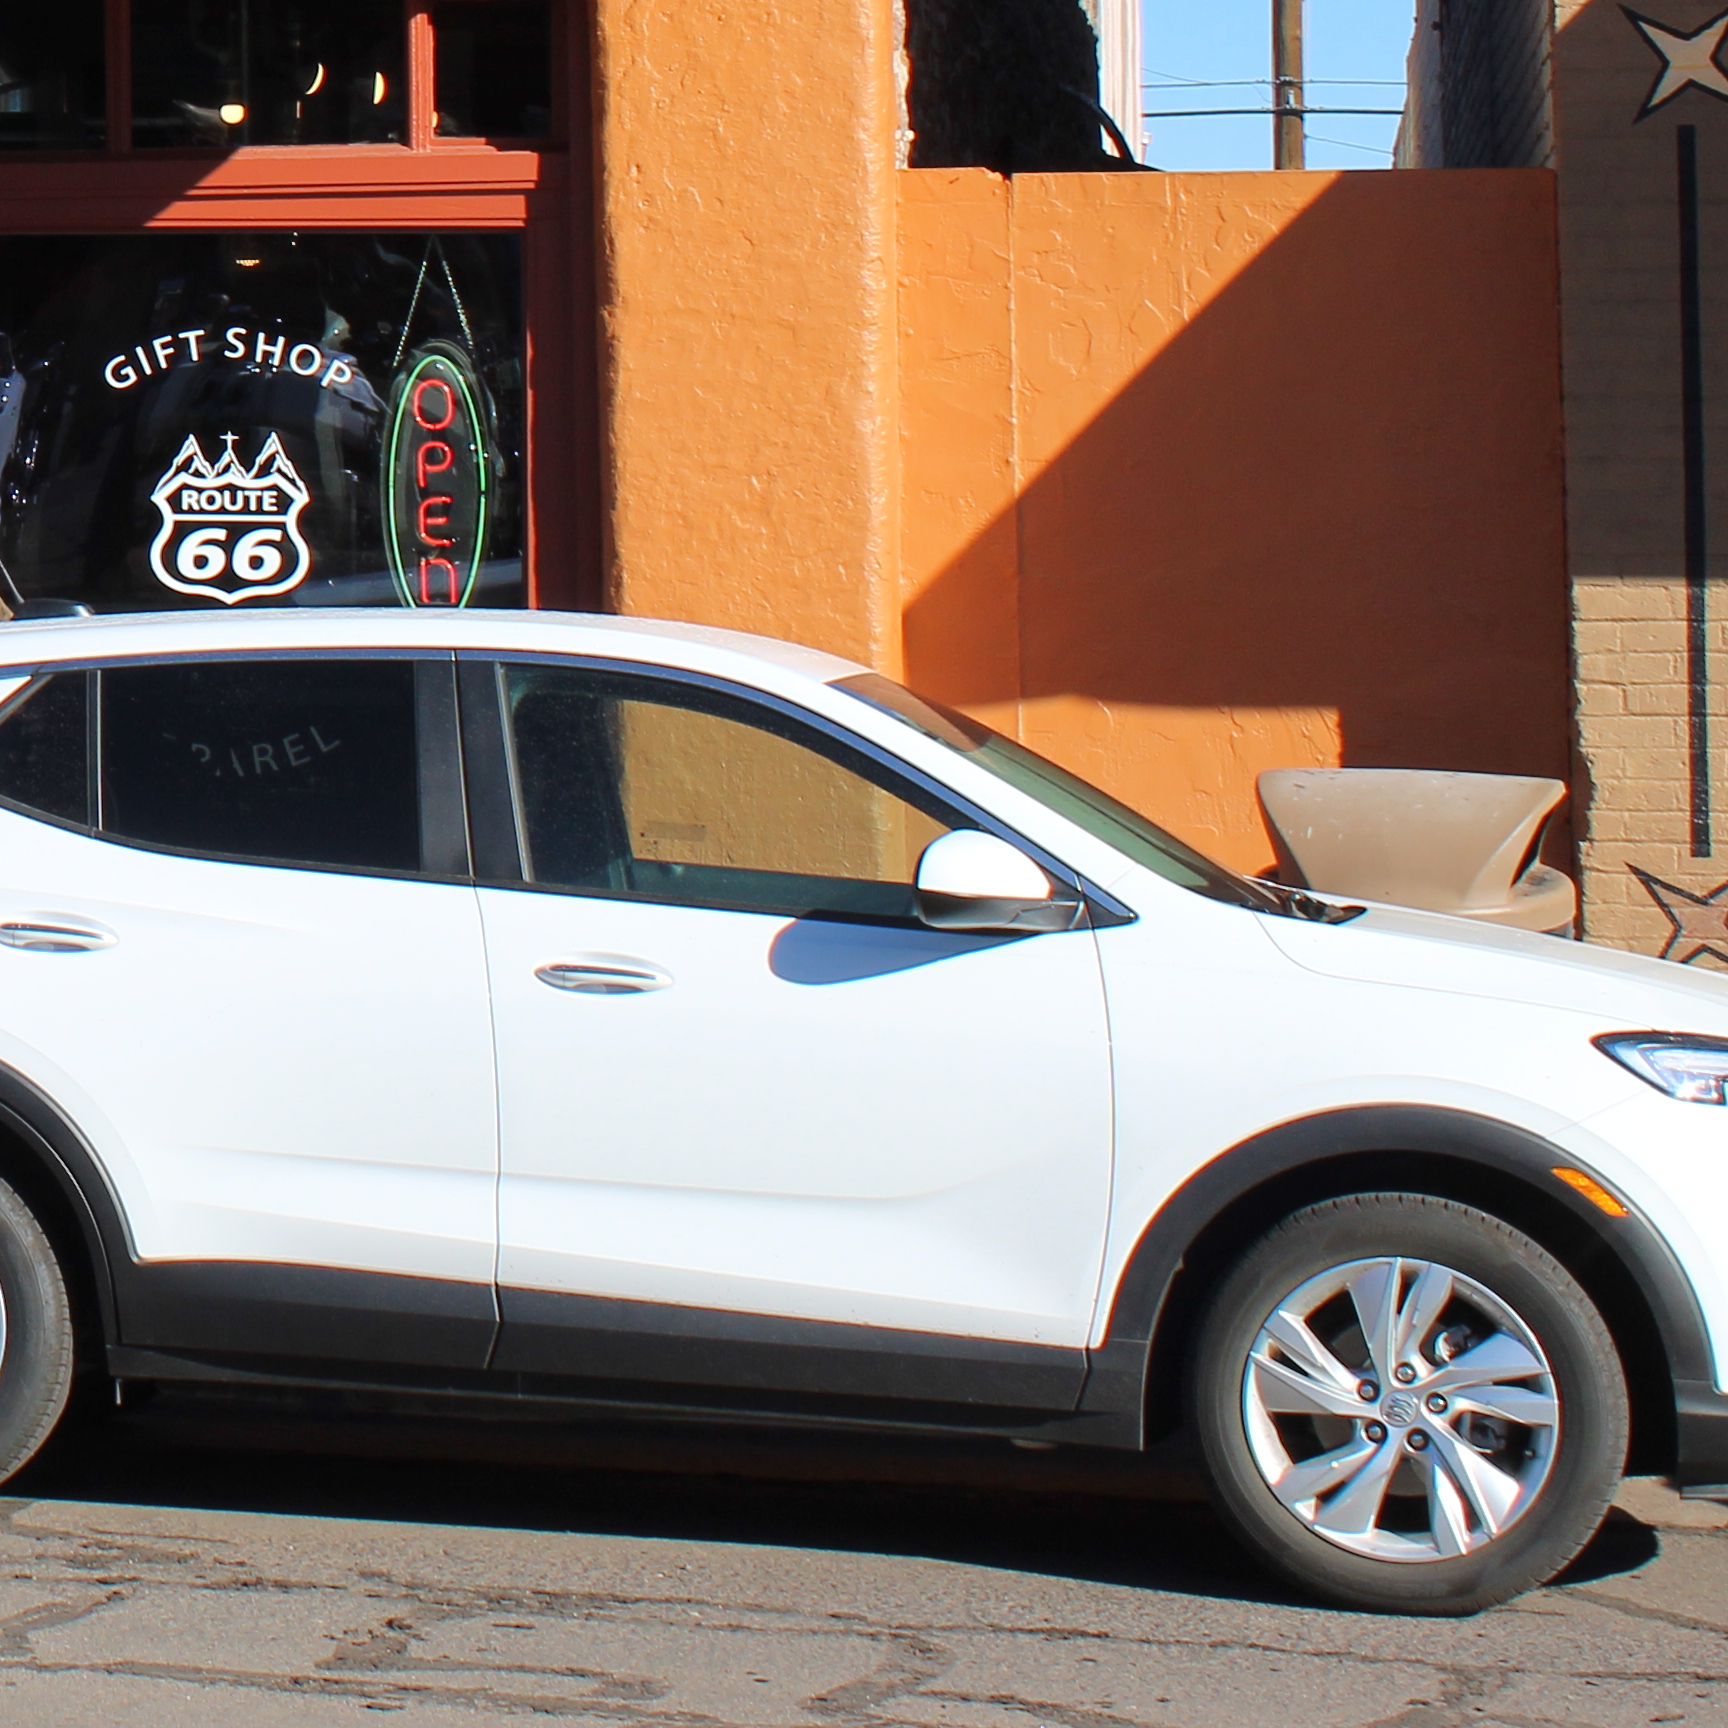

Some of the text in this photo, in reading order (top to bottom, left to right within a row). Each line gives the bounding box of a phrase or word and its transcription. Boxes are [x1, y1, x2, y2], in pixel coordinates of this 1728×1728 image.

[104, 326, 355, 389] GIFT SHOP
[180, 489, 280, 512] ROUTE
[175, 527, 283, 582] 66
